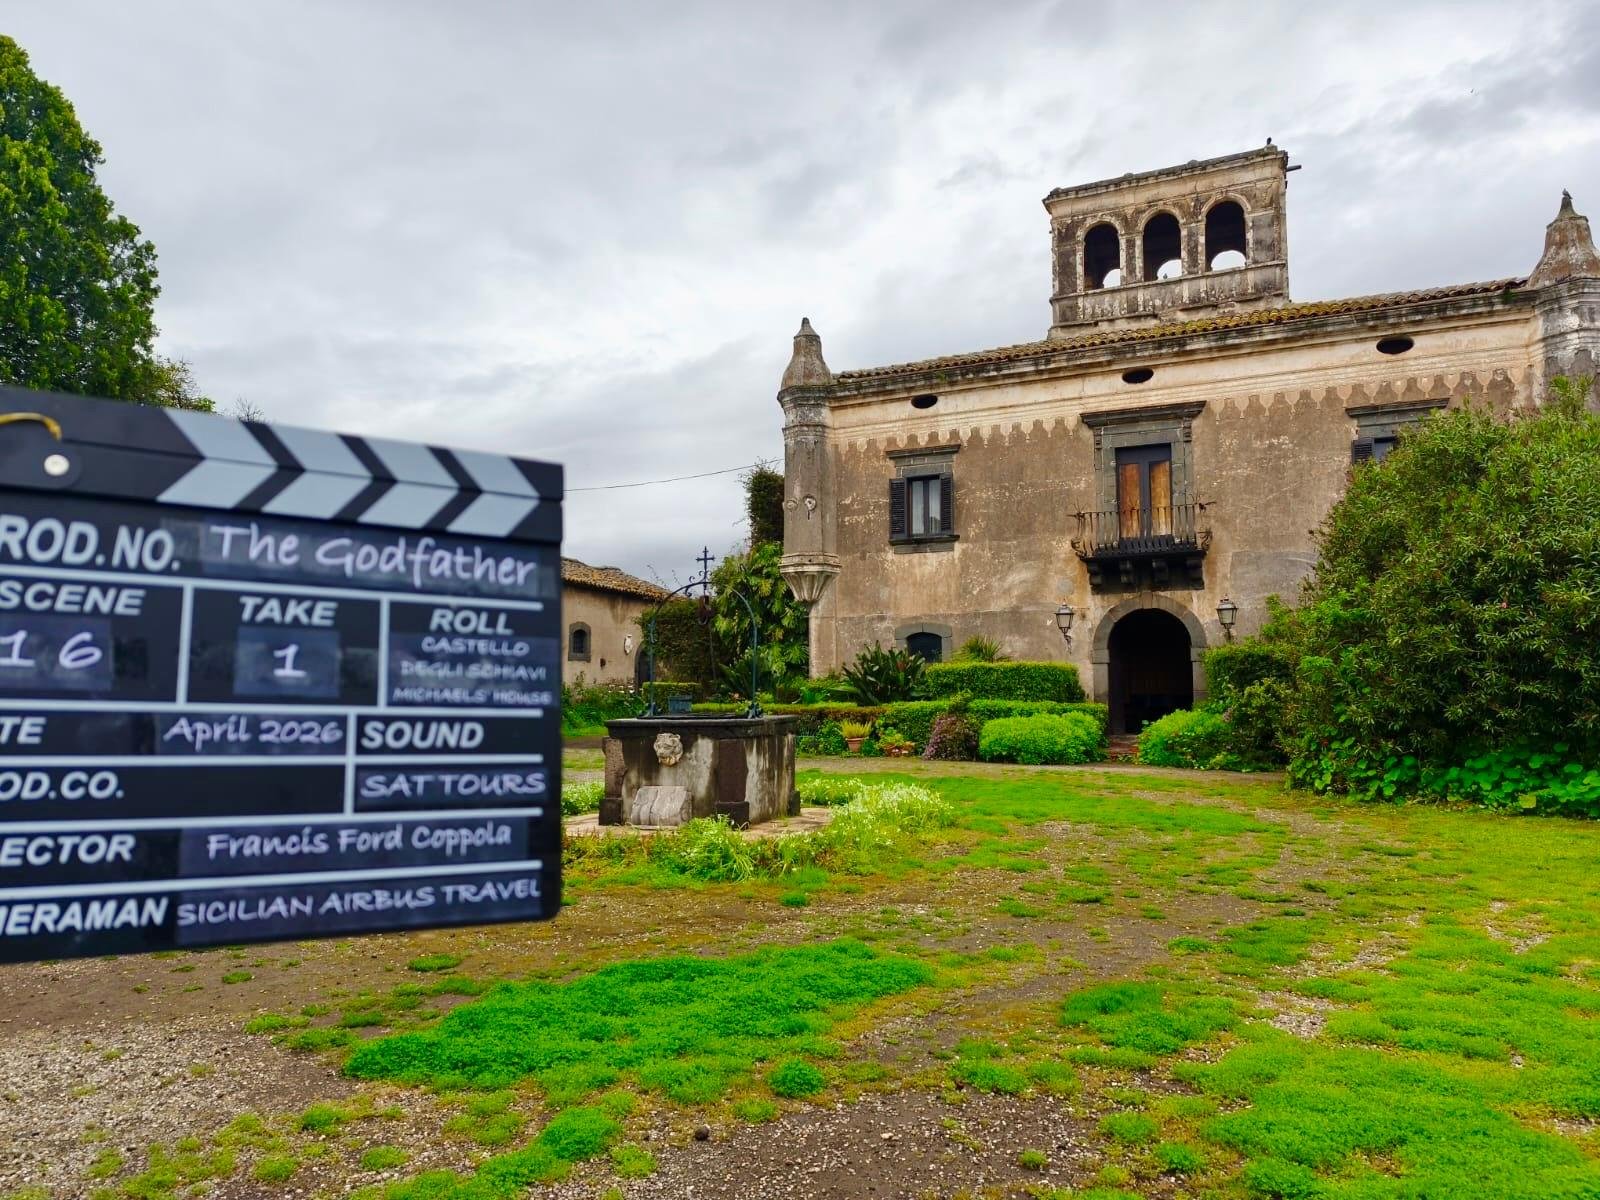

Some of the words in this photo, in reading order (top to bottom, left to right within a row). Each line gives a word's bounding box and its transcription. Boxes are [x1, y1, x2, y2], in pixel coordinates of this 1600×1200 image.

[0, 514, 181, 572] ROD.NO.
[209, 522, 299, 565] The
[314, 536, 537, 588] Godfather
[0, 580, 146, 616] SCENE
[239, 597, 338, 626] TAKE
[429, 608, 514, 636] ROLL
[272, 644, 306, 678] 1
[421, 636, 530, 657] CASTELLO
[0, 716, 46, 744] TE
[163, 715, 252, 751] April
[258, 720, 343, 744] 2026
[361, 721, 484, 750] SOUND
[0, 771, 125, 800] OD.CO.
[360, 775, 433, 797] SAT
[438, 773, 546, 796] TOURS
[0, 834, 136, 867] ECTOR
[206, 826, 330, 860] Francis
[337, 824, 403, 853] Ford
[410, 820, 512, 857] Coppola
[176, 896, 313, 927] SICILIAN
[318, 886, 436, 916] AIRBUS
[441, 878, 541, 903] TRAVEL
